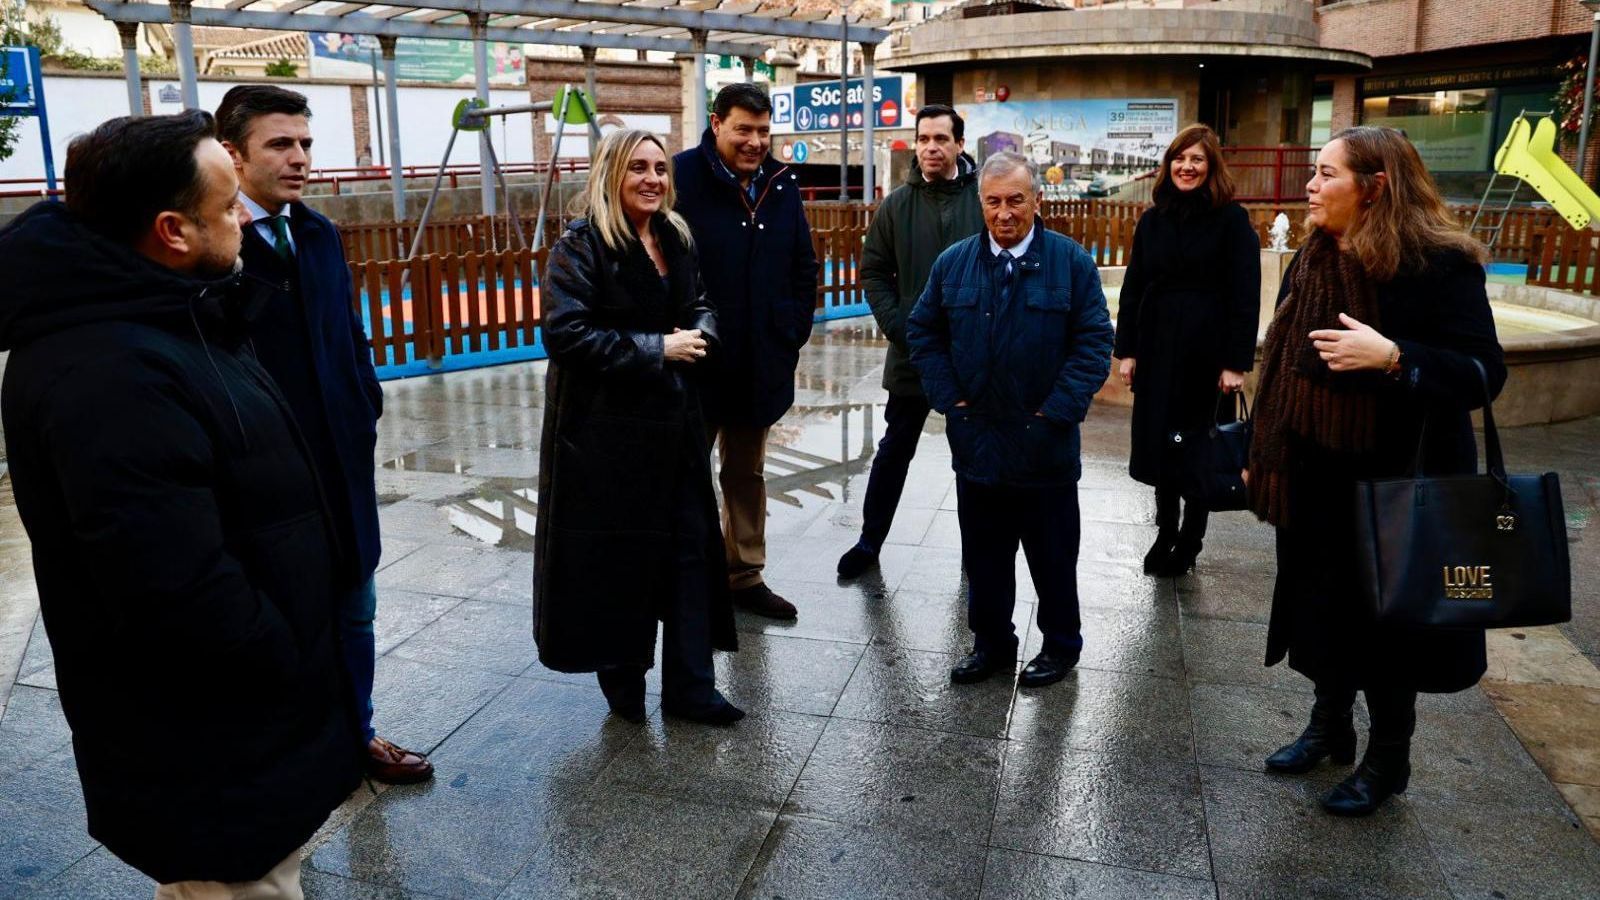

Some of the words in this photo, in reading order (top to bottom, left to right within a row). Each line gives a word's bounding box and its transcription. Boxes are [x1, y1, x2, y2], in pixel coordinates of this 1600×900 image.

[1430, 75, 1456, 86] SURGERY
[811, 85, 882, 107] Sócats
[775, 94, 790, 122] P
[1110, 111, 1125, 122] 39
[1443, 565, 1492, 587] LOVE
